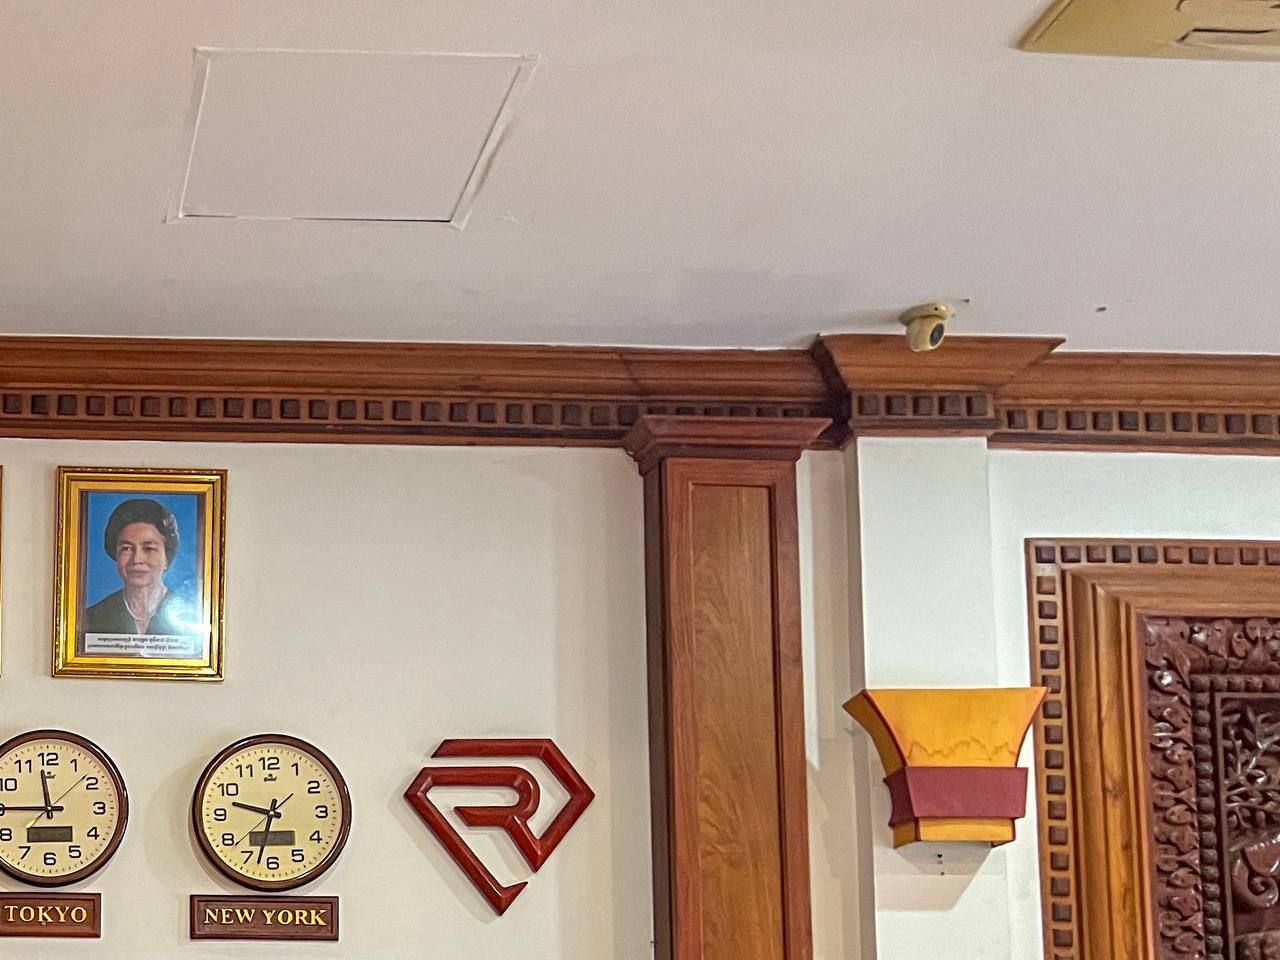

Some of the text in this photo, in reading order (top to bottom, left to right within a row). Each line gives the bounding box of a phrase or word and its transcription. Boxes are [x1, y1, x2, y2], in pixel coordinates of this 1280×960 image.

[37, 752, 59, 766] 12
[70, 759, 78, 772] 1
[258, 756, 280, 771] 12
[14, 759, 32, 773] 11
[235, 764, 253, 778] 11
[291, 763, 299, 776] 1
[86, 777, 99, 790] 2
[217, 783, 239, 796] 10
[307, 780, 321, 794] 2
[93, 801, 106, 815] 3
[315, 805, 328, 819] 3
[213, 808, 227, 822] 9
[0, 828, 12, 841] 8
[86, 826, 100, 840] 4
[222, 833, 234, 846] 8
[309, 830, 322, 843] 4
[18, 846, 31, 859] 7
[68, 845, 82, 858] 5
[240, 851, 254, 864] 7
[291, 849, 305, 862] 5
[43, 852, 57, 865] 6
[266, 856, 279, 870] 6
[4, 905, 87, 923] TOKYO
[203, 908, 327, 926] NEW YORK
